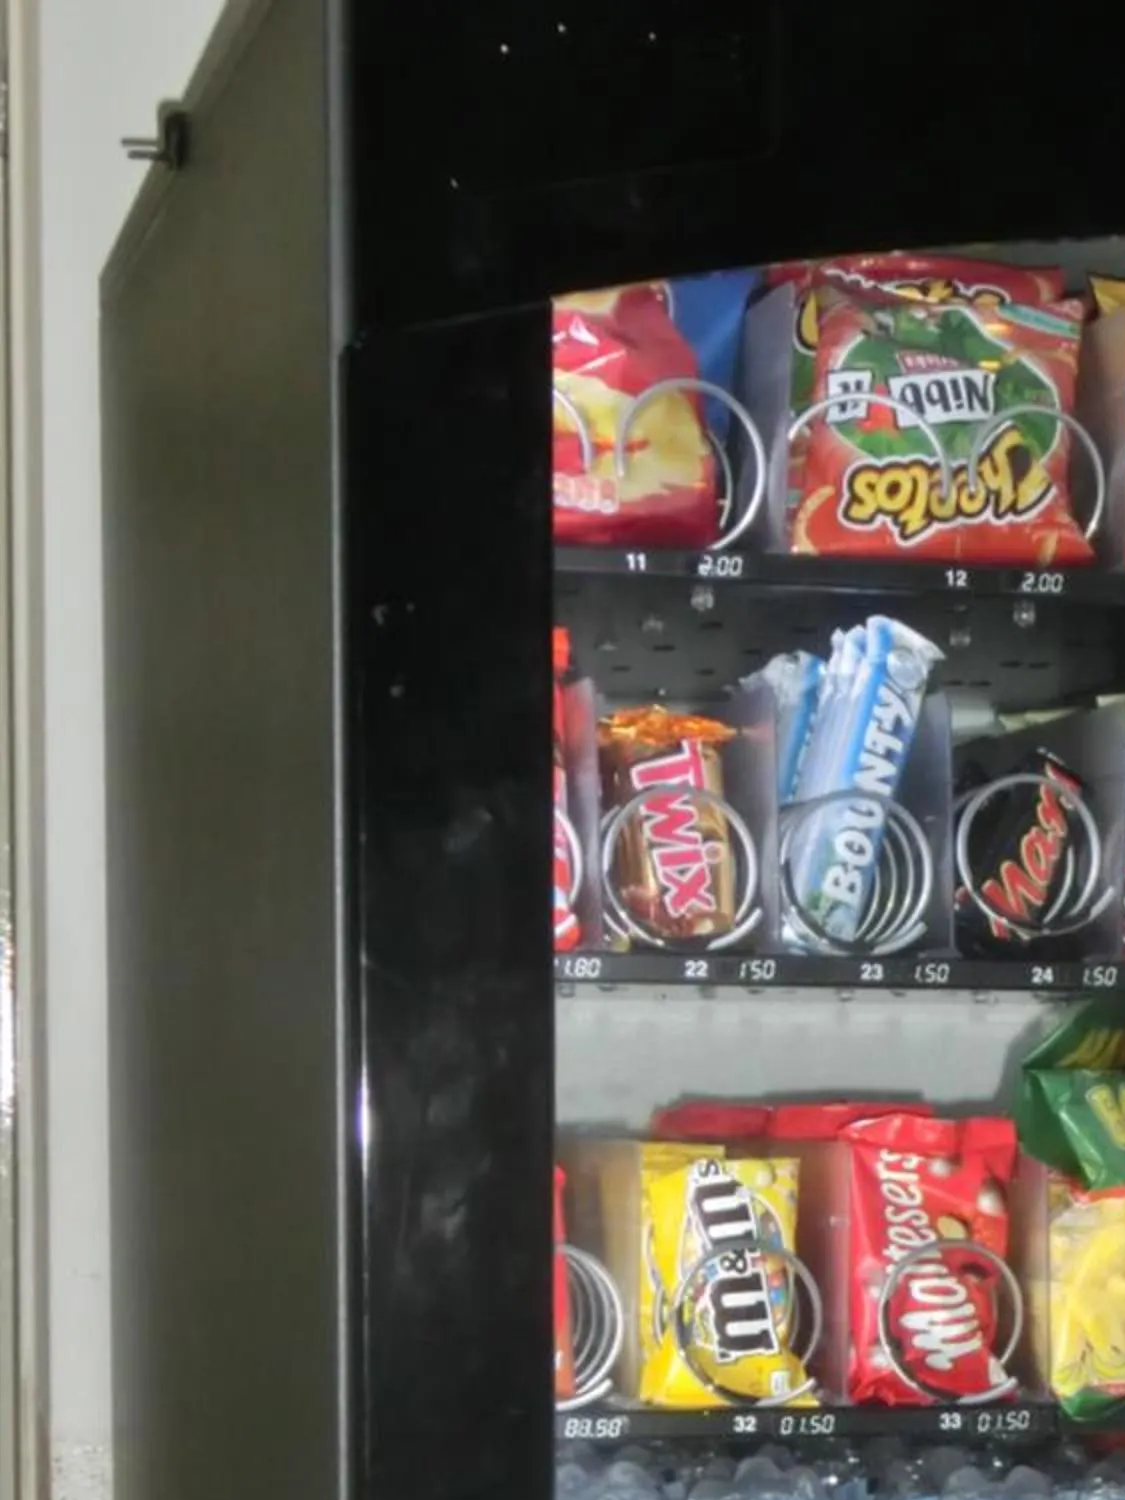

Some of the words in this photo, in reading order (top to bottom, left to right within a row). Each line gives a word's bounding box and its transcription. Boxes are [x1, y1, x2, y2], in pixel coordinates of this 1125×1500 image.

[842, 423, 1057, 542] Cheetos
[626, 553, 646, 570] 11
[946, 570, 967, 587] 12
[1021, 572, 1064, 593] 2.00
[821, 680, 915, 907] BOUNTY
[685, 960, 708, 977] 22
[861, 963, 883, 980] 23
[1032, 967, 1053, 983] 24
[734, 1415, 757, 1432] 32
[940, 1412, 962, 1429] 33
